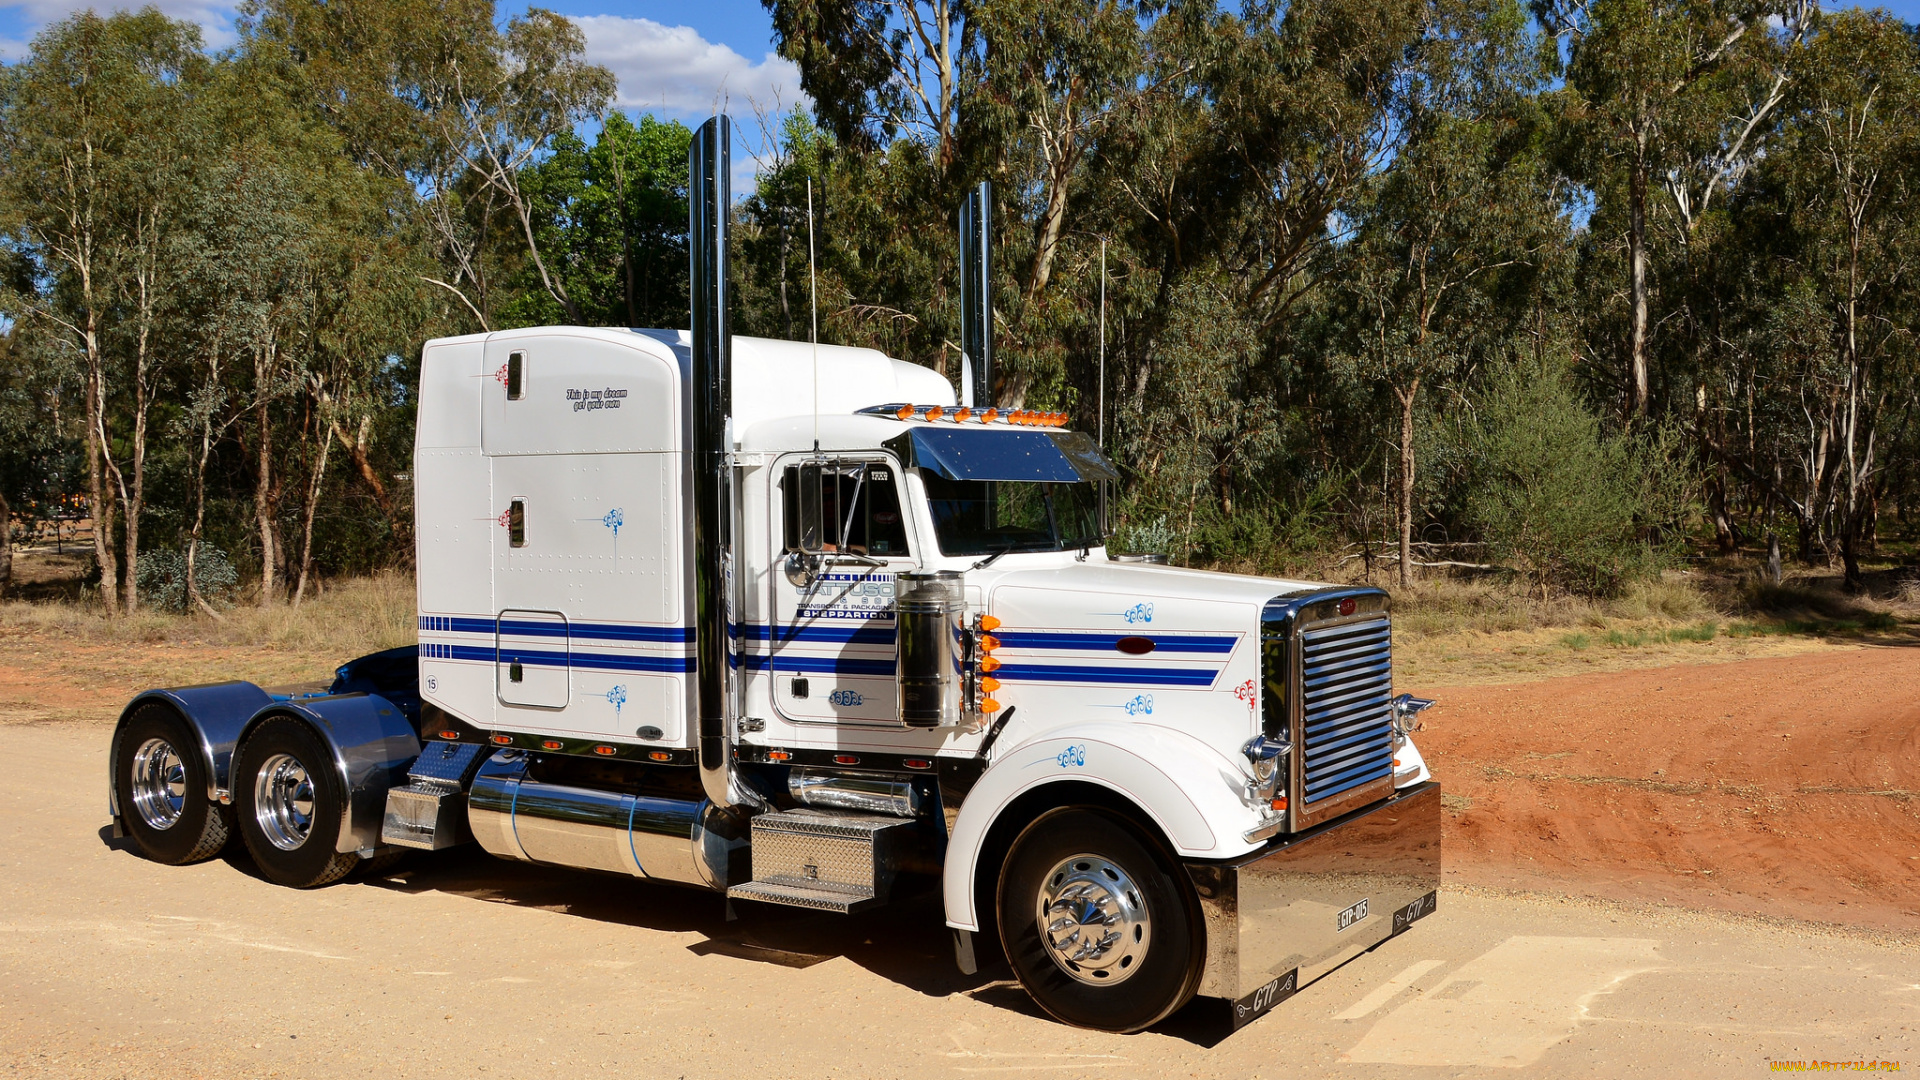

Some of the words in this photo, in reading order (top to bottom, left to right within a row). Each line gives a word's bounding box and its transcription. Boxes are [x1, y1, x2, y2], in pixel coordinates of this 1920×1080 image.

[566, 389, 581, 400] This
[583, 389, 589, 399] is
[591, 391, 602, 401] my
[604, 387, 627, 398] dream
[587, 400, 604, 411] your
[605, 400, 620, 409] own
[804, 610, 887, 619] SHEPPARTON
[427, 679, 436, 689] 15
[1406, 897, 1425, 922] GTP
[1253, 979, 1278, 1012] GTP
